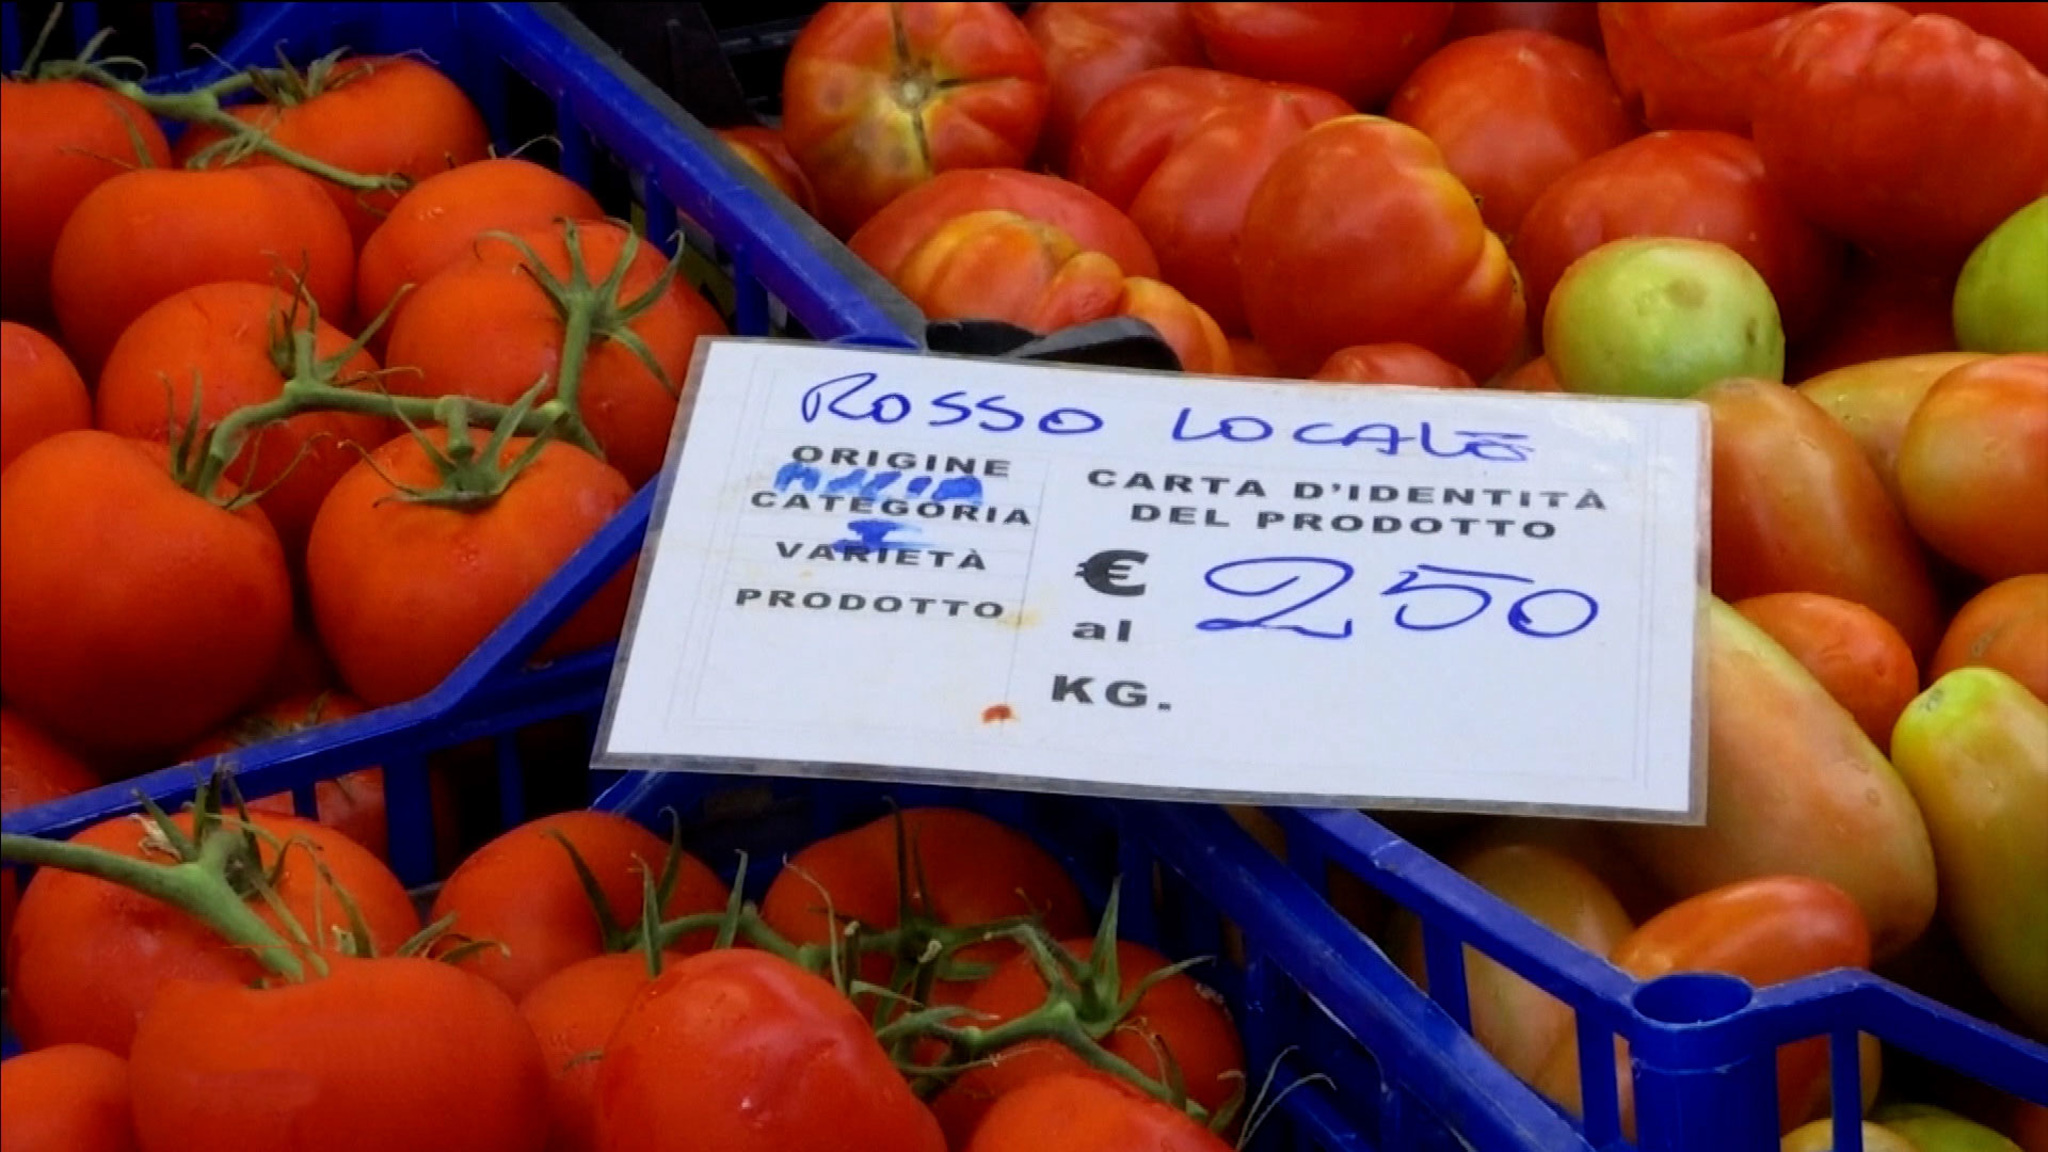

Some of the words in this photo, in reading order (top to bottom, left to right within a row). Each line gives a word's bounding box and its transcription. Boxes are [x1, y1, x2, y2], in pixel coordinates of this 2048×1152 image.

[801, 372, 1104, 434] ROSSO
[791, 445, 1012, 478] ORIGINE
[750, 490, 1031, 526] CATEGORIA
[1087, 469, 1267, 497] CARTA
[1294, 480, 1608, 511] D'IDENTITÀ
[1131, 503, 1230, 527] DEL
[1256, 510, 1557, 540] PRODOTTO
[776, 541, 987, 571] VARIETÀ
[735, 588, 1005, 620] PRODOTTO
[1072, 619, 1132, 643] al
[1050, 674, 1172, 712] KG.
